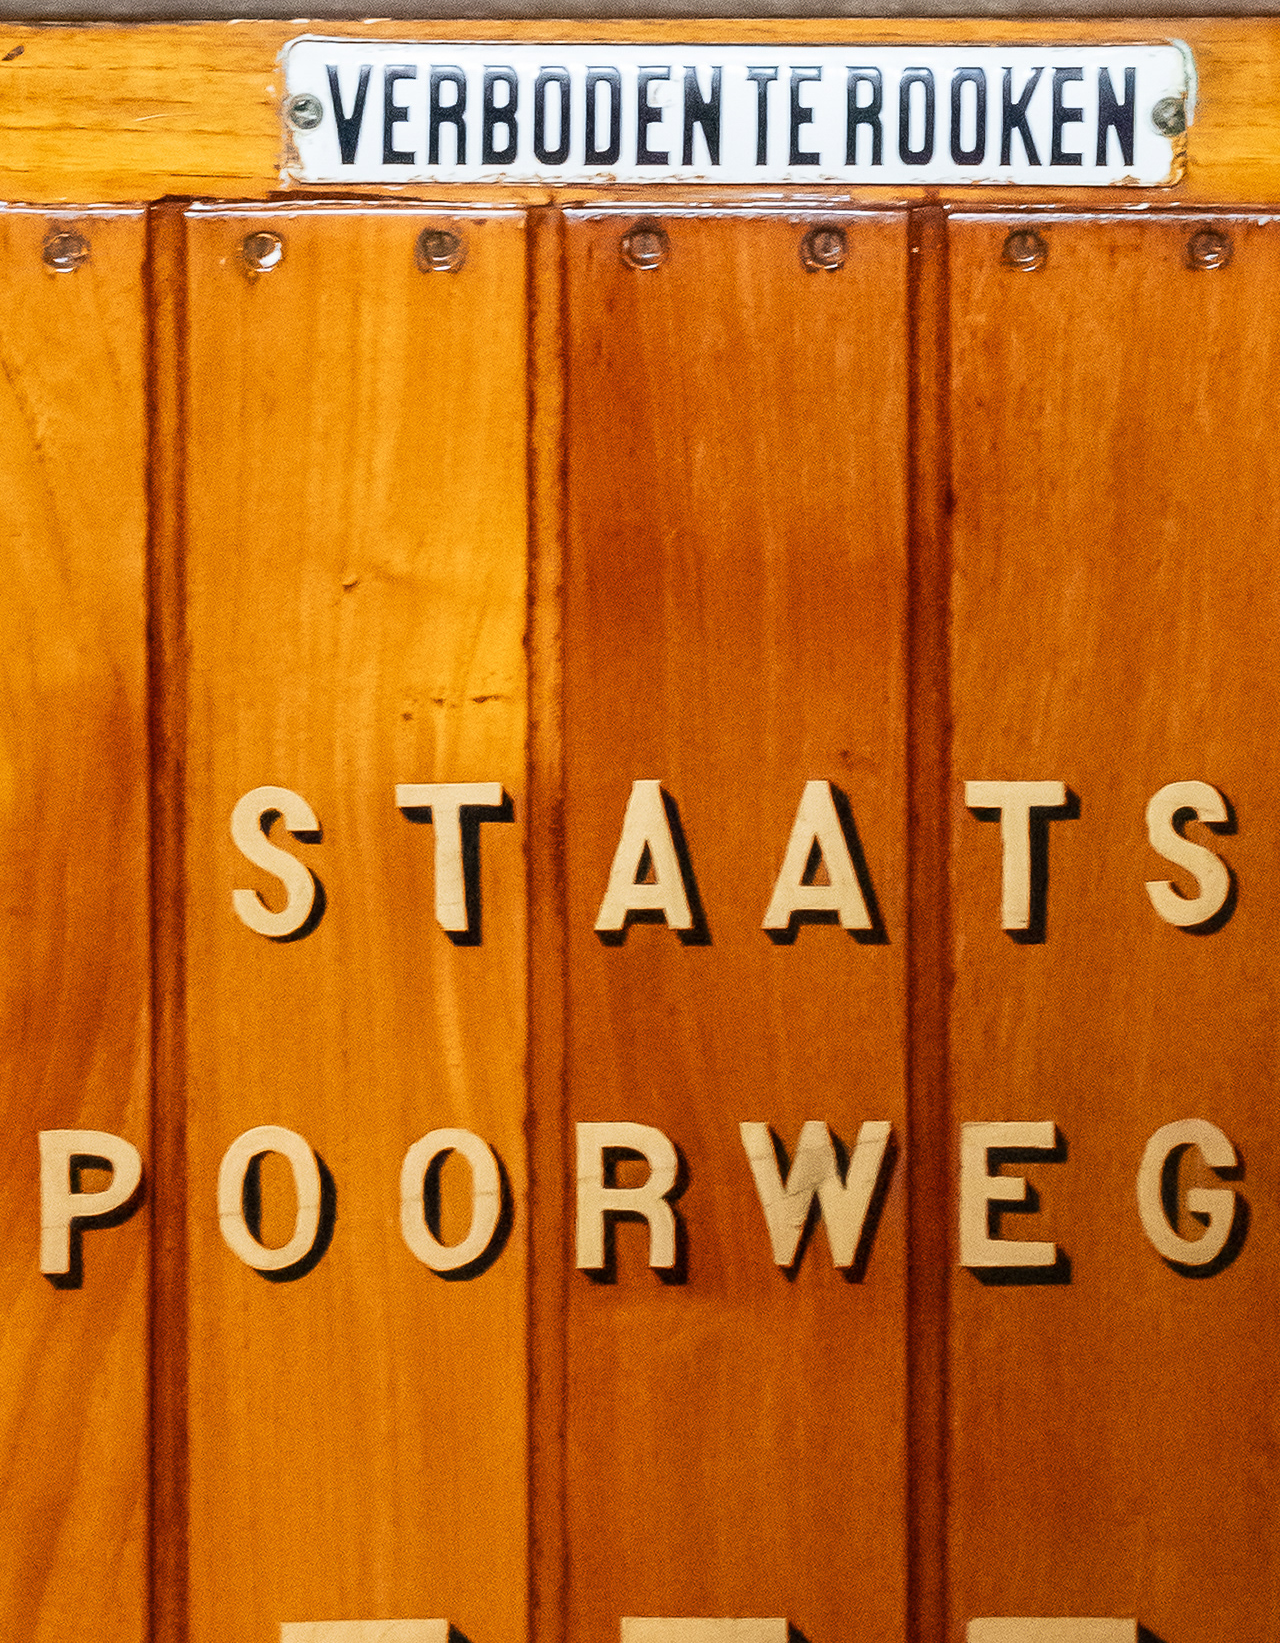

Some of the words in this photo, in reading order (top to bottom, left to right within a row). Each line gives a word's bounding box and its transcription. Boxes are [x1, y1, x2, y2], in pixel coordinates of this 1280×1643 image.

[325, 63, 721, 167] VERBODEN
[744, 66, 823, 167] TE
[844, 66, 1138, 168] ROOKEN
[229, 778, 1238, 941] STAATS
